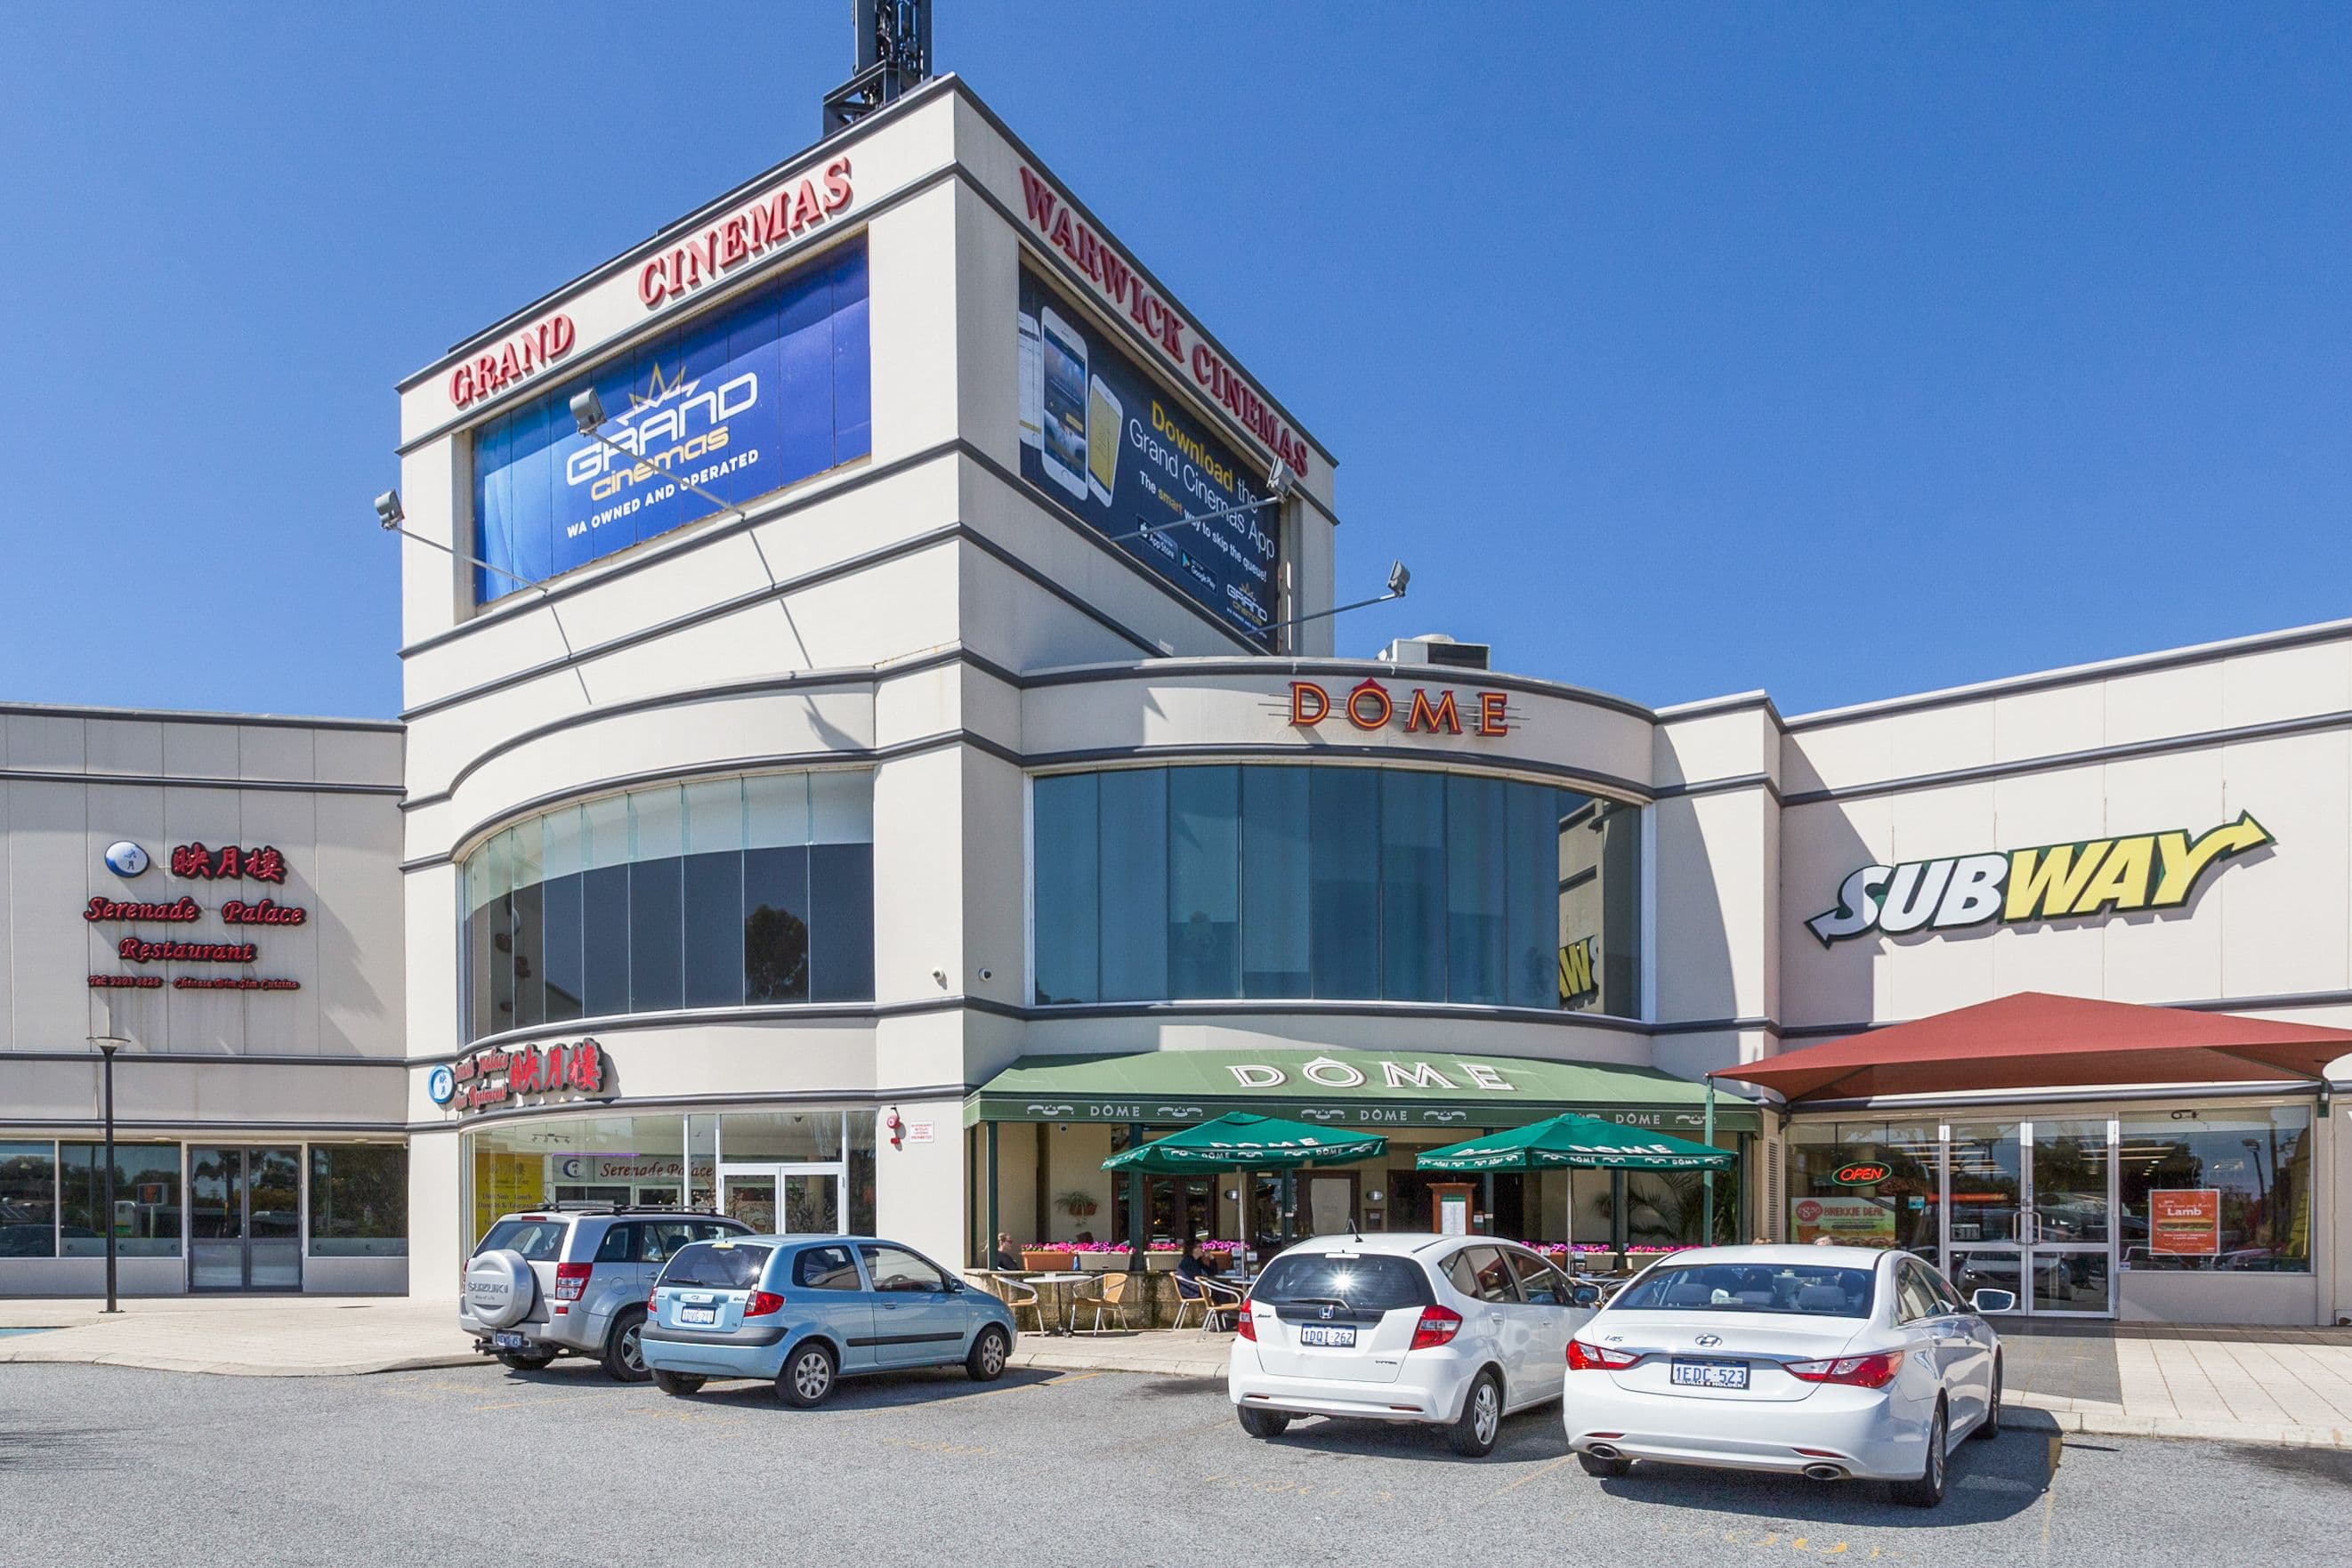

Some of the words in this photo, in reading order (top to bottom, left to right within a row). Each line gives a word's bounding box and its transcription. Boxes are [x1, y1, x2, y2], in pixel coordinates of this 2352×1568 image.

[449, 313, 575, 407] GRAND
[639, 157, 852, 305] CINEMAS
[1020, 166, 1184, 363] WARWICK
[1192, 344, 1308, 478] CINEMAS
[567, 372, 757, 486] GRAND
[1152, 400, 1233, 493] Download
[1238, 478, 1257, 513] the
[567, 524, 587, 537] WA
[592, 498, 640, 528] OWNED
[645, 484, 675, 506] AND
[681, 449, 759, 491] OPERATED
[1129, 418, 1178, 480] Grand
[1184, 465, 1244, 534] Cinemas
[1249, 520, 1274, 561] App
[1140, 471, 1156, 494] The
[1159, 489, 1183, 515] smart
[1202, 521, 1211, 537] to
[1212, 532, 1228, 553] skip
[1230, 545, 1241, 562] the
[1243, 557, 1266, 582] queue!
[85, 897, 198, 922] Serenade
[223, 900, 303, 924] Palace
[1805, 810, 2275, 949] SUBWAY
[120, 938, 253, 962] Restaurant
[601, 1161, 663, 1178] Serenade
[667, 1161, 712, 1178] Paace
[1839, 1168, 1883, 1181] OPEN
[2167, 1208, 2202, 1216] Lamb
[468, 1282, 508, 1293] SUZUKI
